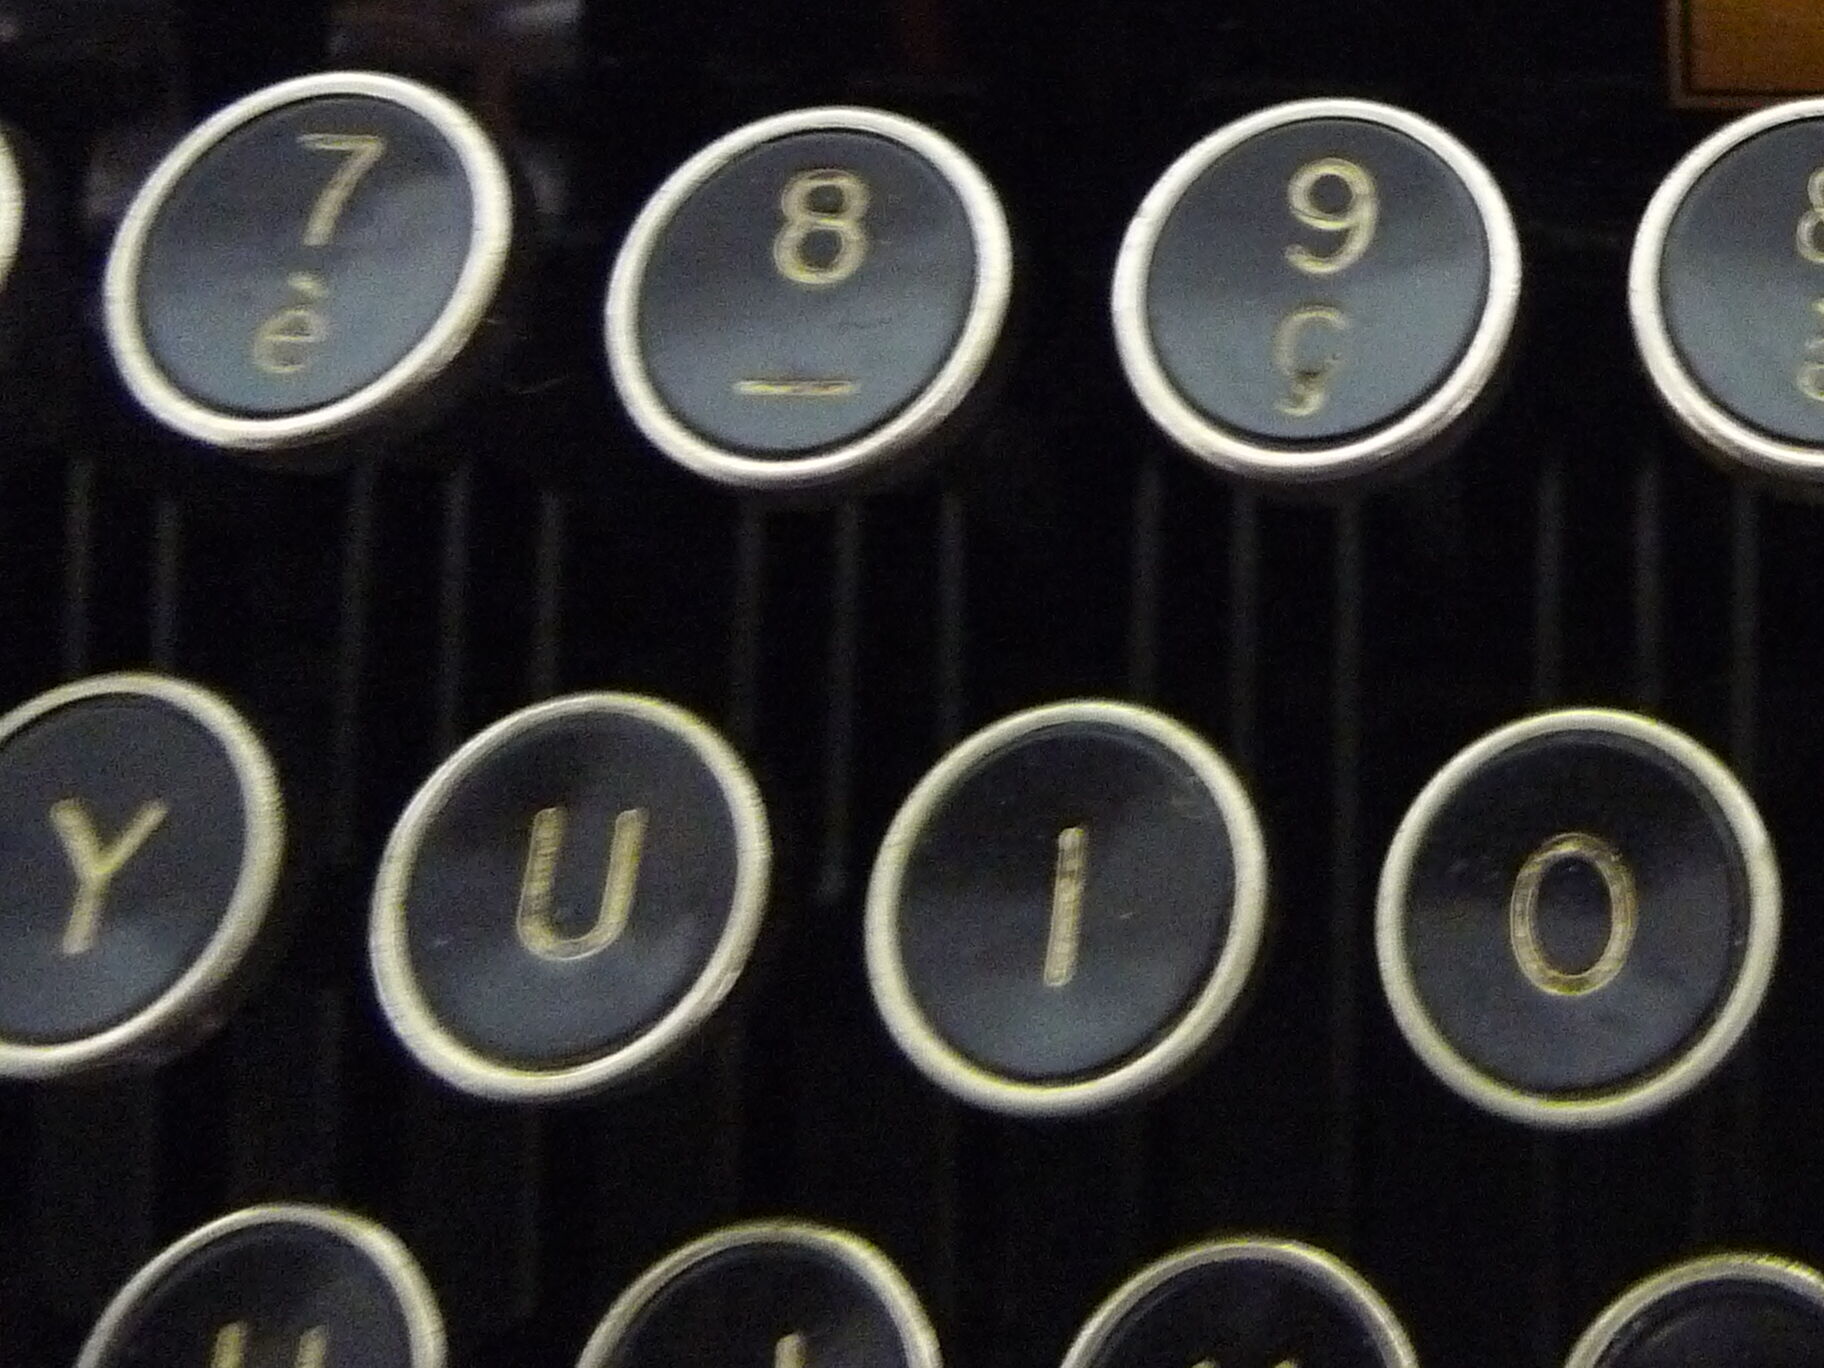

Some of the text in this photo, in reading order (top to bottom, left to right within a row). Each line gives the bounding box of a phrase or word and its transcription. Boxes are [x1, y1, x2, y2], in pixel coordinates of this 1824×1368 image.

[297, 132, 385, 246] 7
[772, 168, 871, 286] 8
[1283, 157, 1380, 275] 9
[49, 797, 168, 956] Y
[515, 805, 649, 962] U
[1042, 825, 1089, 988] I
[1508, 832, 1637, 998] O
